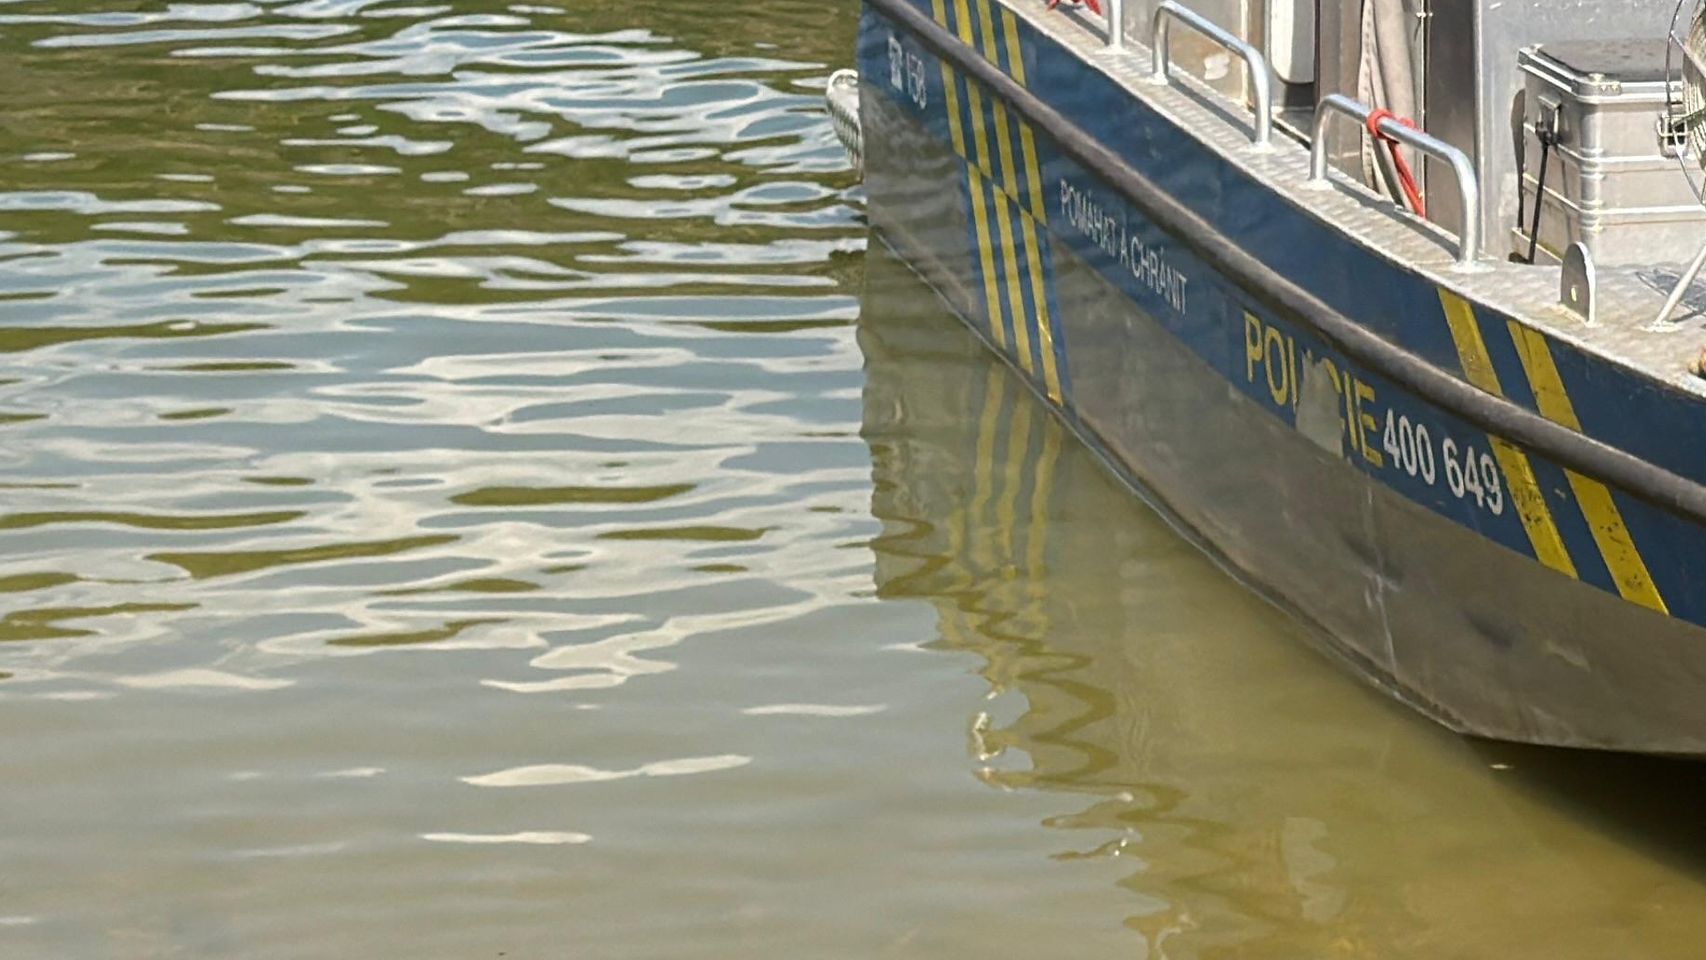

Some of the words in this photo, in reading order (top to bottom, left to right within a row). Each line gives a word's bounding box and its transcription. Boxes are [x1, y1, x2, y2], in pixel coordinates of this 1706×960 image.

[1120, 227, 1130, 269] A
[1131, 236, 1187, 315] CHRÁNIT
[1243, 310, 1383, 468] POLIE
[1383, 408, 1435, 486] 400
[1443, 437, 1503, 516] 649
